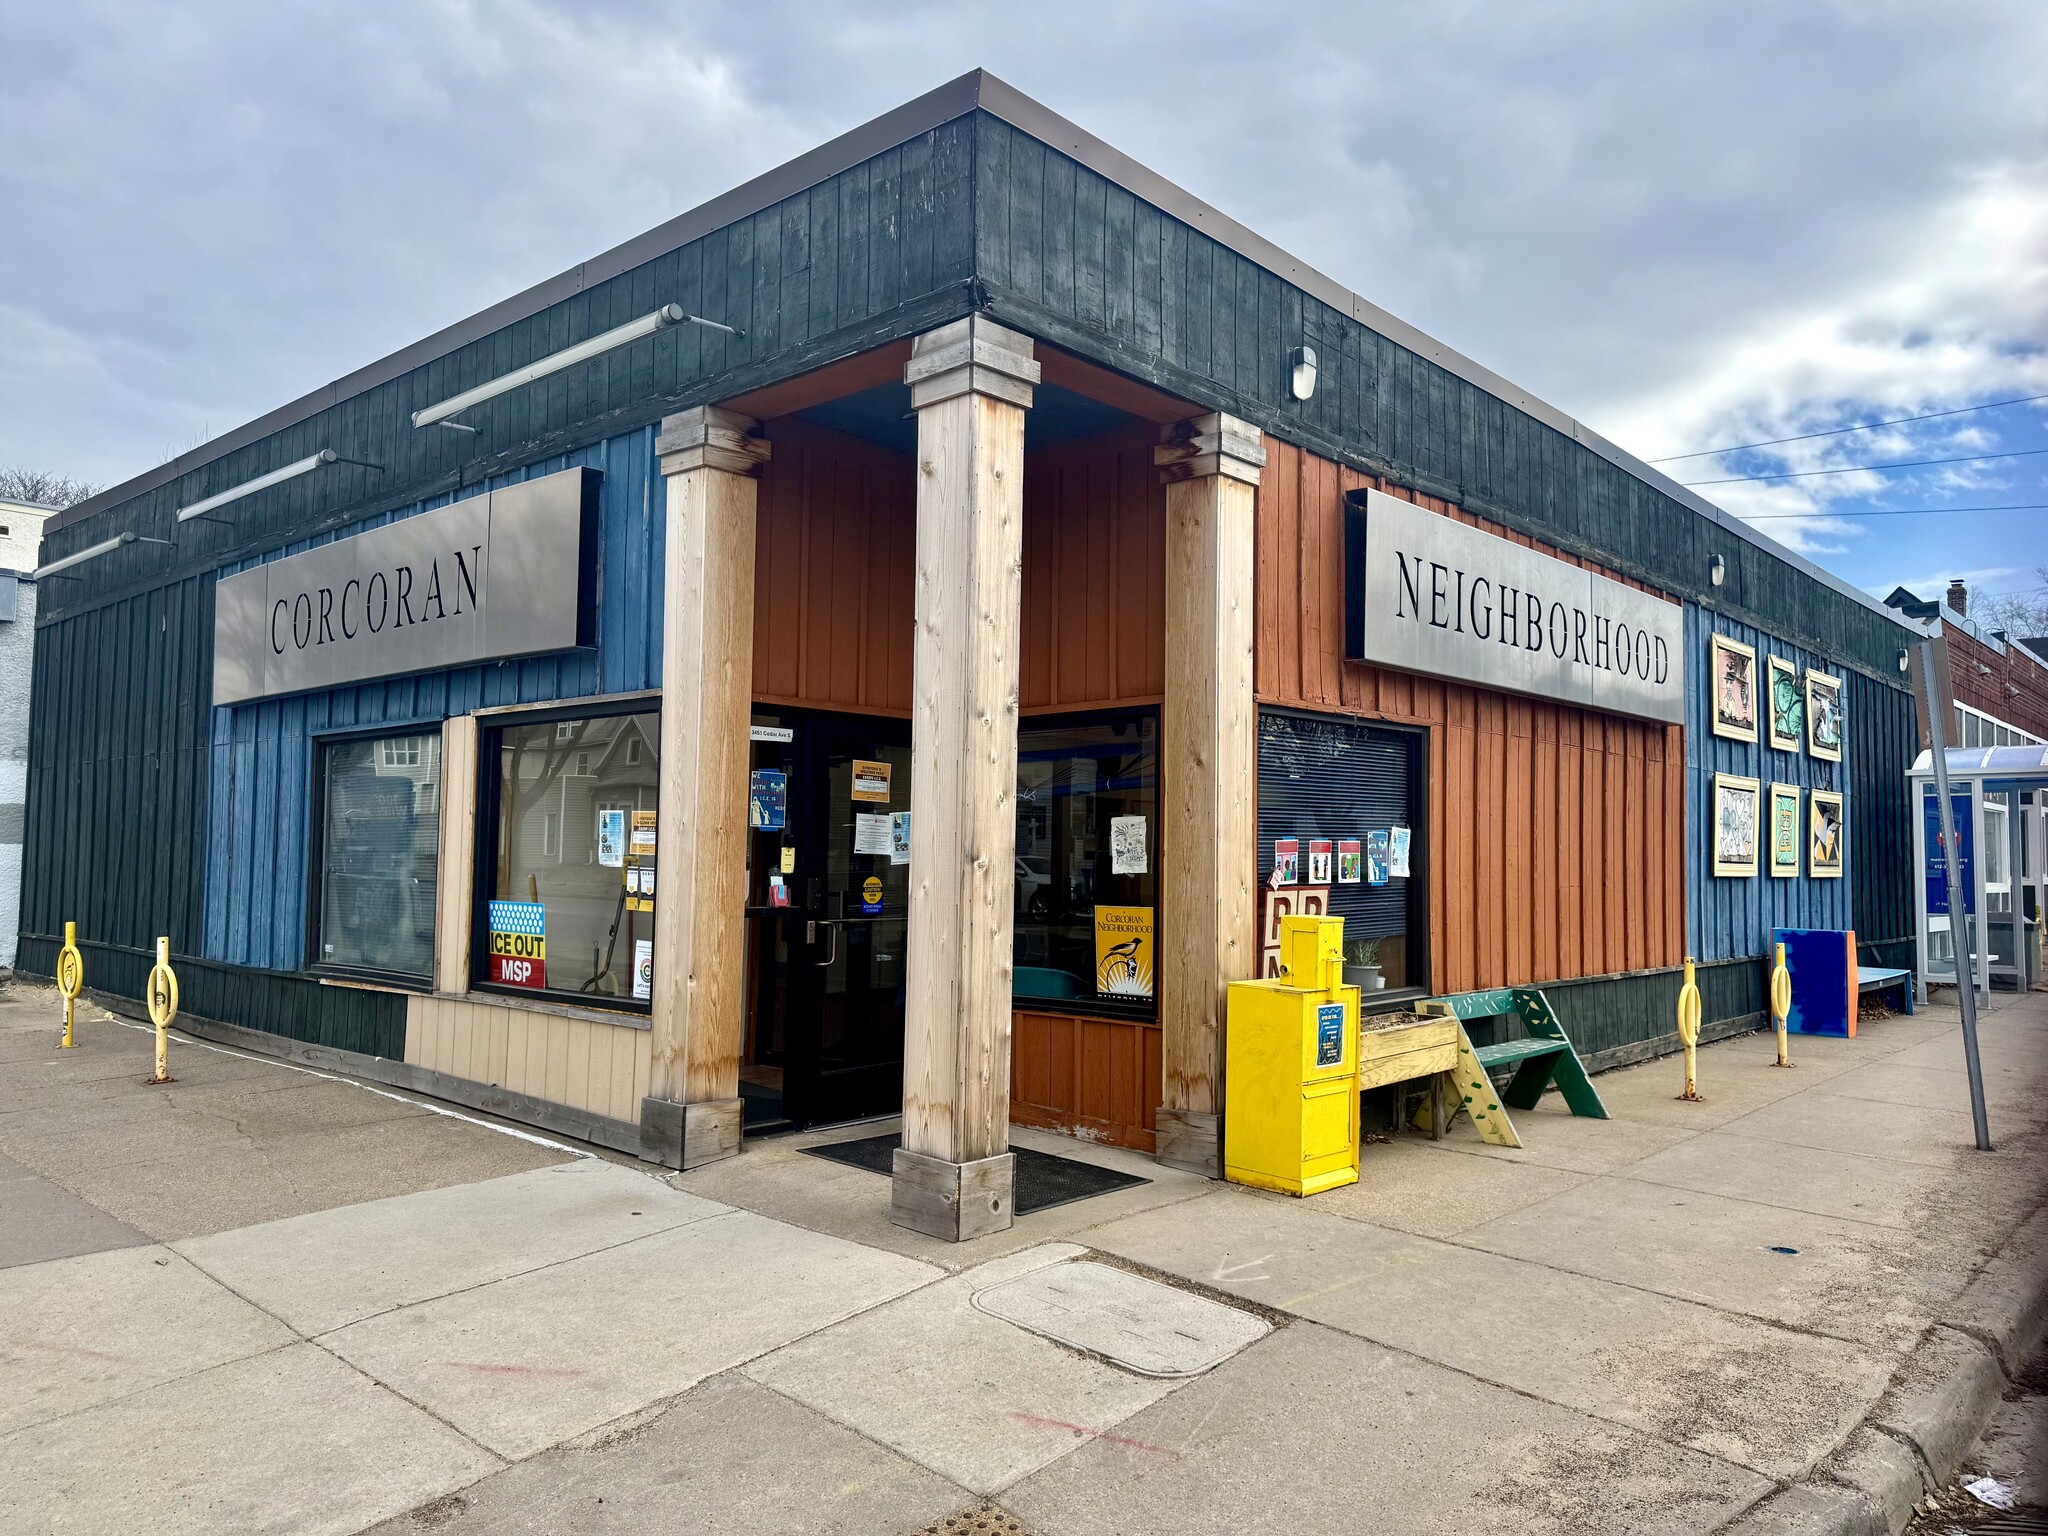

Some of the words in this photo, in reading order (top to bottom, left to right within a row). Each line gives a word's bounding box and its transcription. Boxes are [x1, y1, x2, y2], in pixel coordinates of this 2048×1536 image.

[271, 545, 482, 655] CORCORAN
[1395, 550, 1669, 685] NEIGHBORHOOD
[1097, 921, 1152, 933] NEIGHBORHOOD
[1105, 912, 1143, 923] CORCORAN
[490, 932, 512, 954] ICE
[514, 934, 544, 958] OUT
[501, 959, 532, 982] MSP
